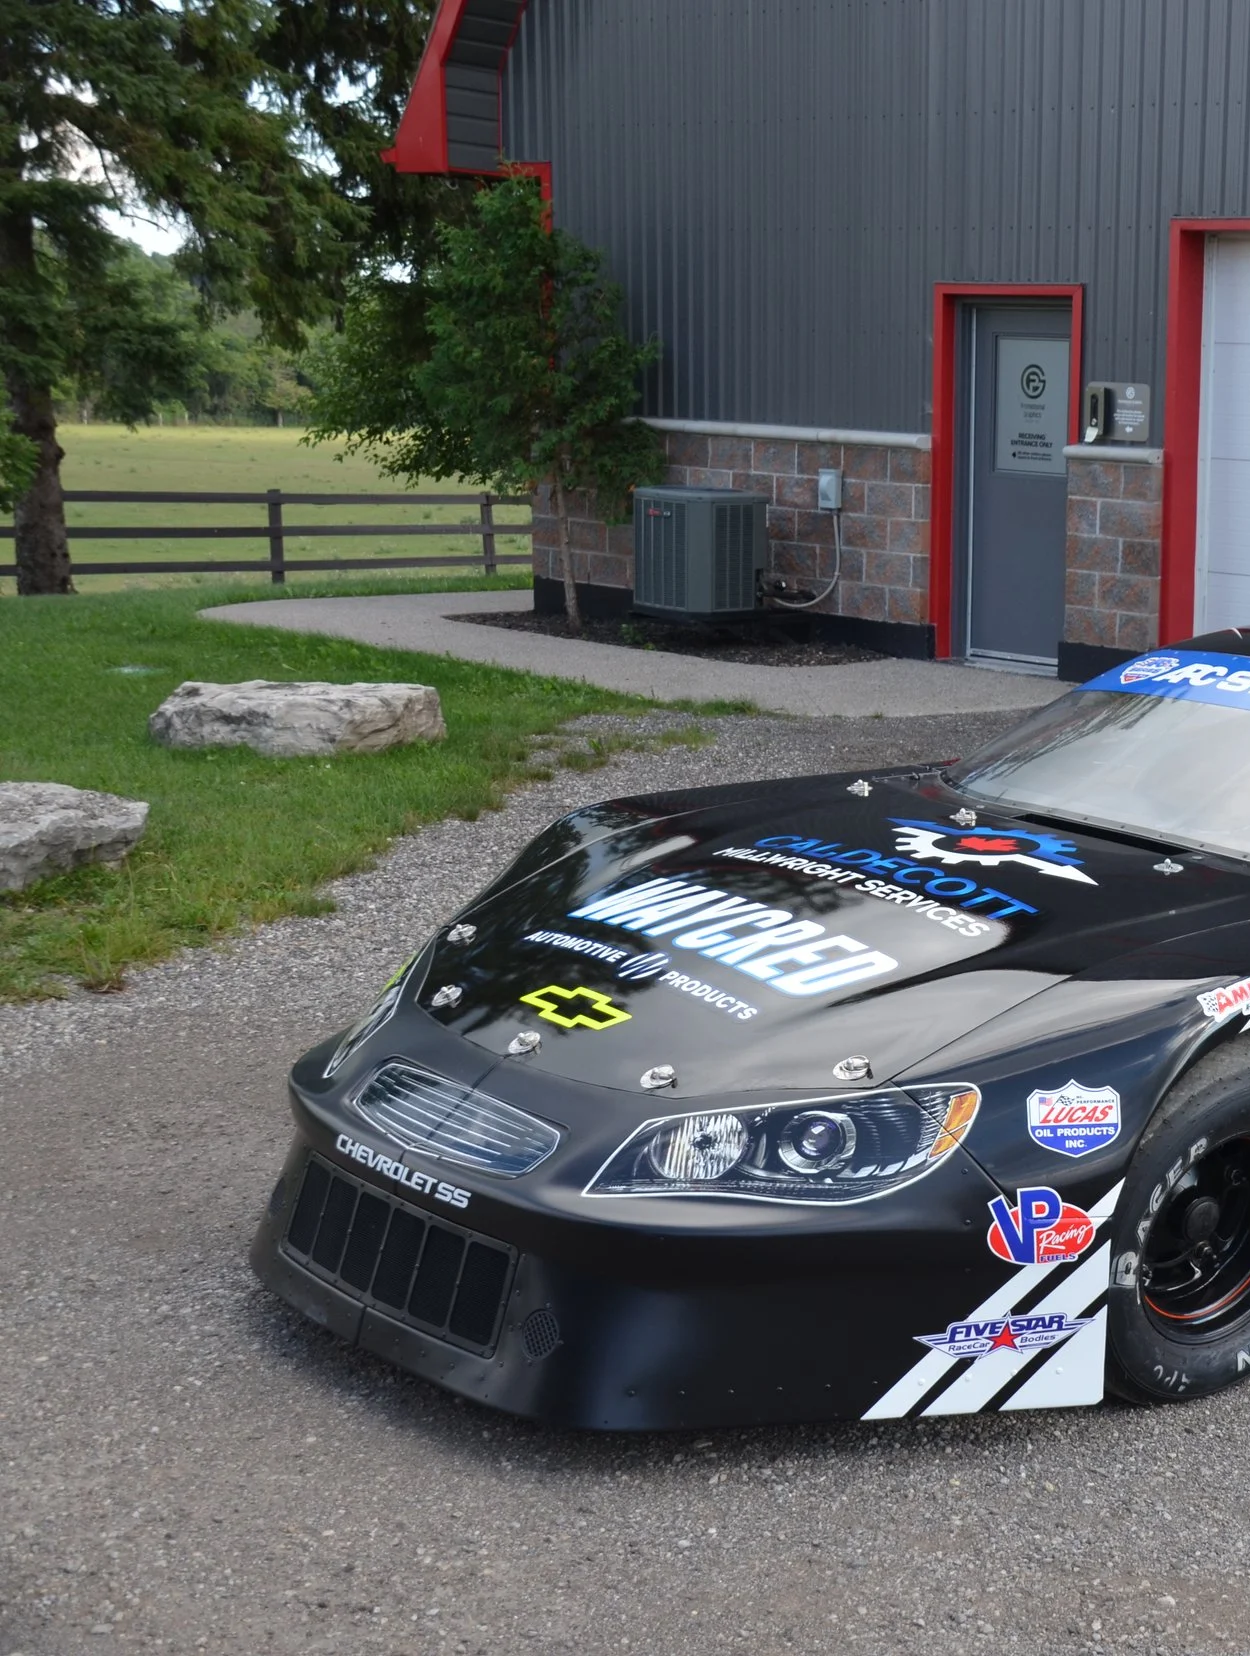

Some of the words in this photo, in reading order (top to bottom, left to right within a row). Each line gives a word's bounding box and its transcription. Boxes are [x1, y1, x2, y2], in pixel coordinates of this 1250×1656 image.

[1011, 439, 1038, 448] ENTRANCE
[1039, 440, 1053, 448] ONLY
[1152, 663, 1229, 686] APC
[712, 847, 866, 884] MILLWRIGHT
[855, 878, 990, 937] SERVICES
[752, 835, 1040, 920] CALDECOTT
[567, 876, 899, 996] WAYCRED
[524, 930, 627, 962] AUTOMOTIVE
[659, 970, 758, 1020] PRODUCTS
[1039, 1105, 1113, 1124] LUCAS
[1035, 1129, 1054, 1137] OIL
[1057, 1126, 1115, 1137] PRODUCTS
[1065, 1140, 1088, 1148] INC.
[336, 1134, 438, 1194] CHEVROLET
[434, 1181, 472, 1209] SS
[988, 1186, 1062, 1265] VP
[1039, 1223, 1093, 1254] Racing
[1040, 1252, 1076, 1262] FUELS
[949, 1341, 991, 1352] RaceCar
[1019, 1334, 1056, 1345] Bodies
[950, 1321, 1005, 1343] FIVE
[1010, 1314, 1066, 1332] STAR
